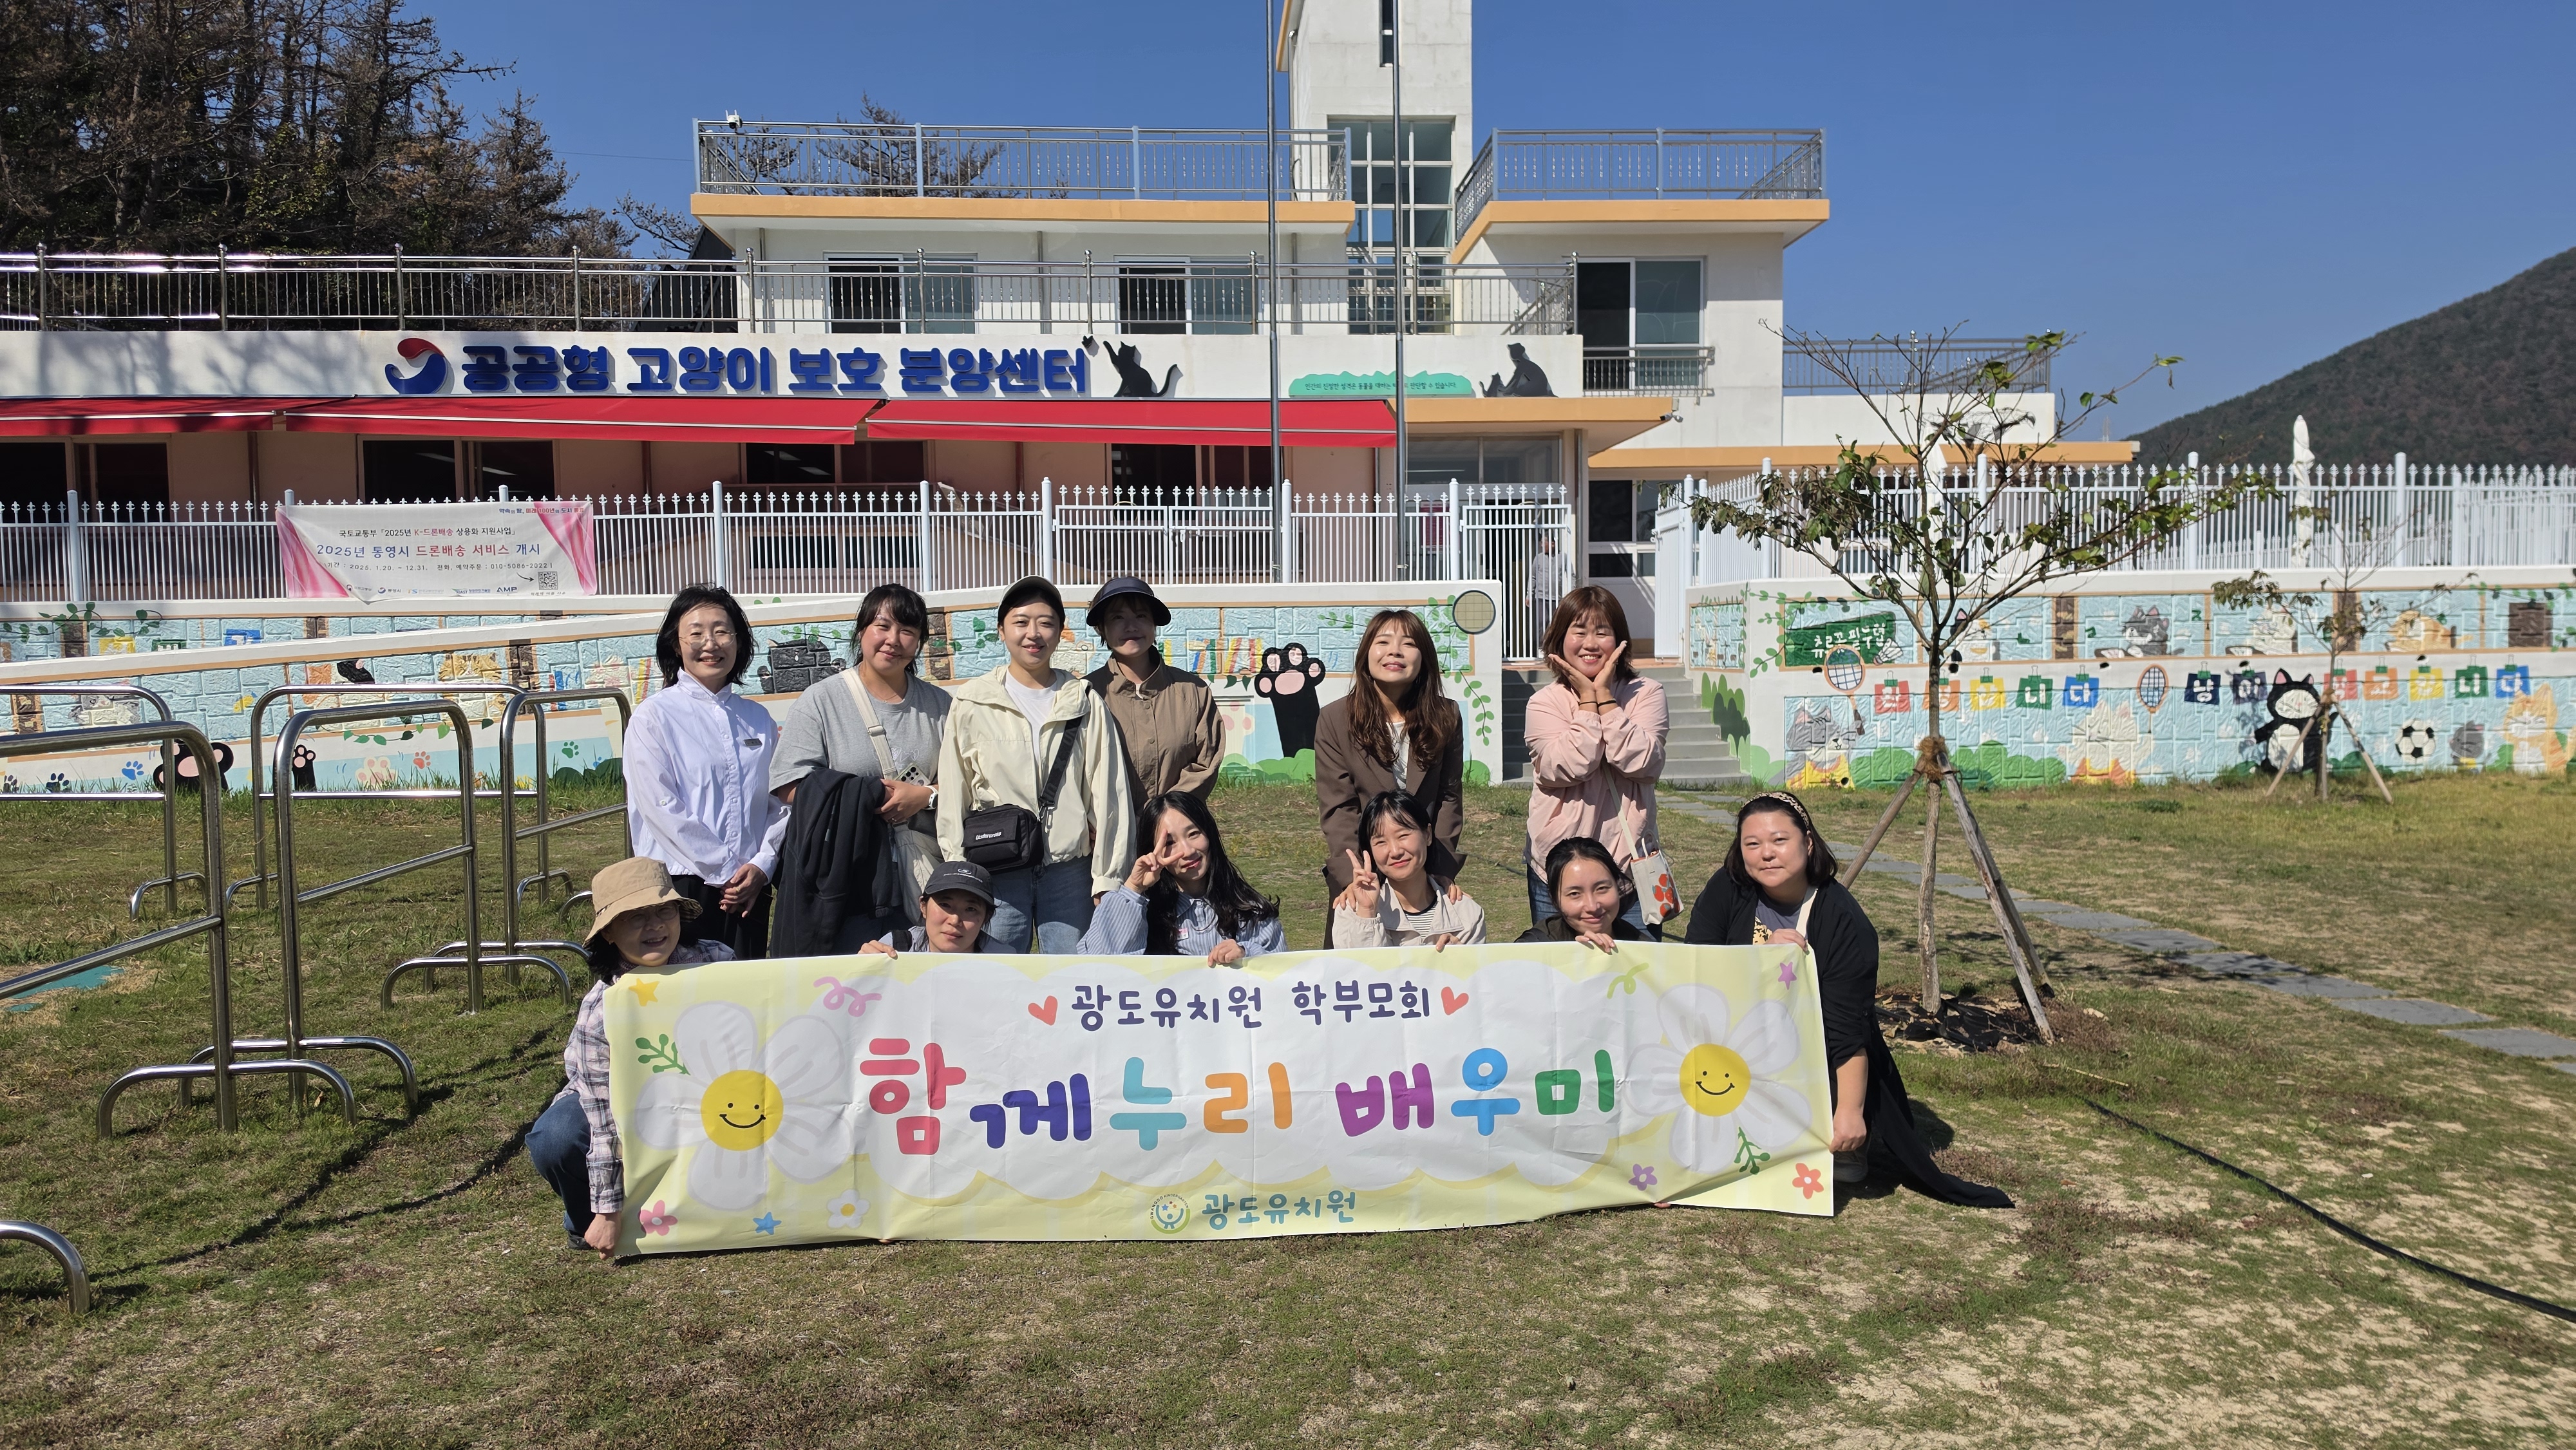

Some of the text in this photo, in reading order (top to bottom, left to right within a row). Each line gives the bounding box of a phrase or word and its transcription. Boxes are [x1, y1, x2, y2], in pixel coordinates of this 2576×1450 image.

[462, 345, 1086, 393] 공공형 고양이 보호 분양센터
[316, 543, 540, 558] 2025년 통영시 드론배송 서비스 개시
[339, 529, 377, 538] 국토교통부
[414, 528, 453, 536] K-드론배송
[455, 527, 478, 536] 상용화
[1072, 980, 1431, 1033] 광도유치원 학부모회
[860, 1038, 1615, 1156] 함께누리 배우미
[1202, 1190, 1356, 1230] 광도유치원
